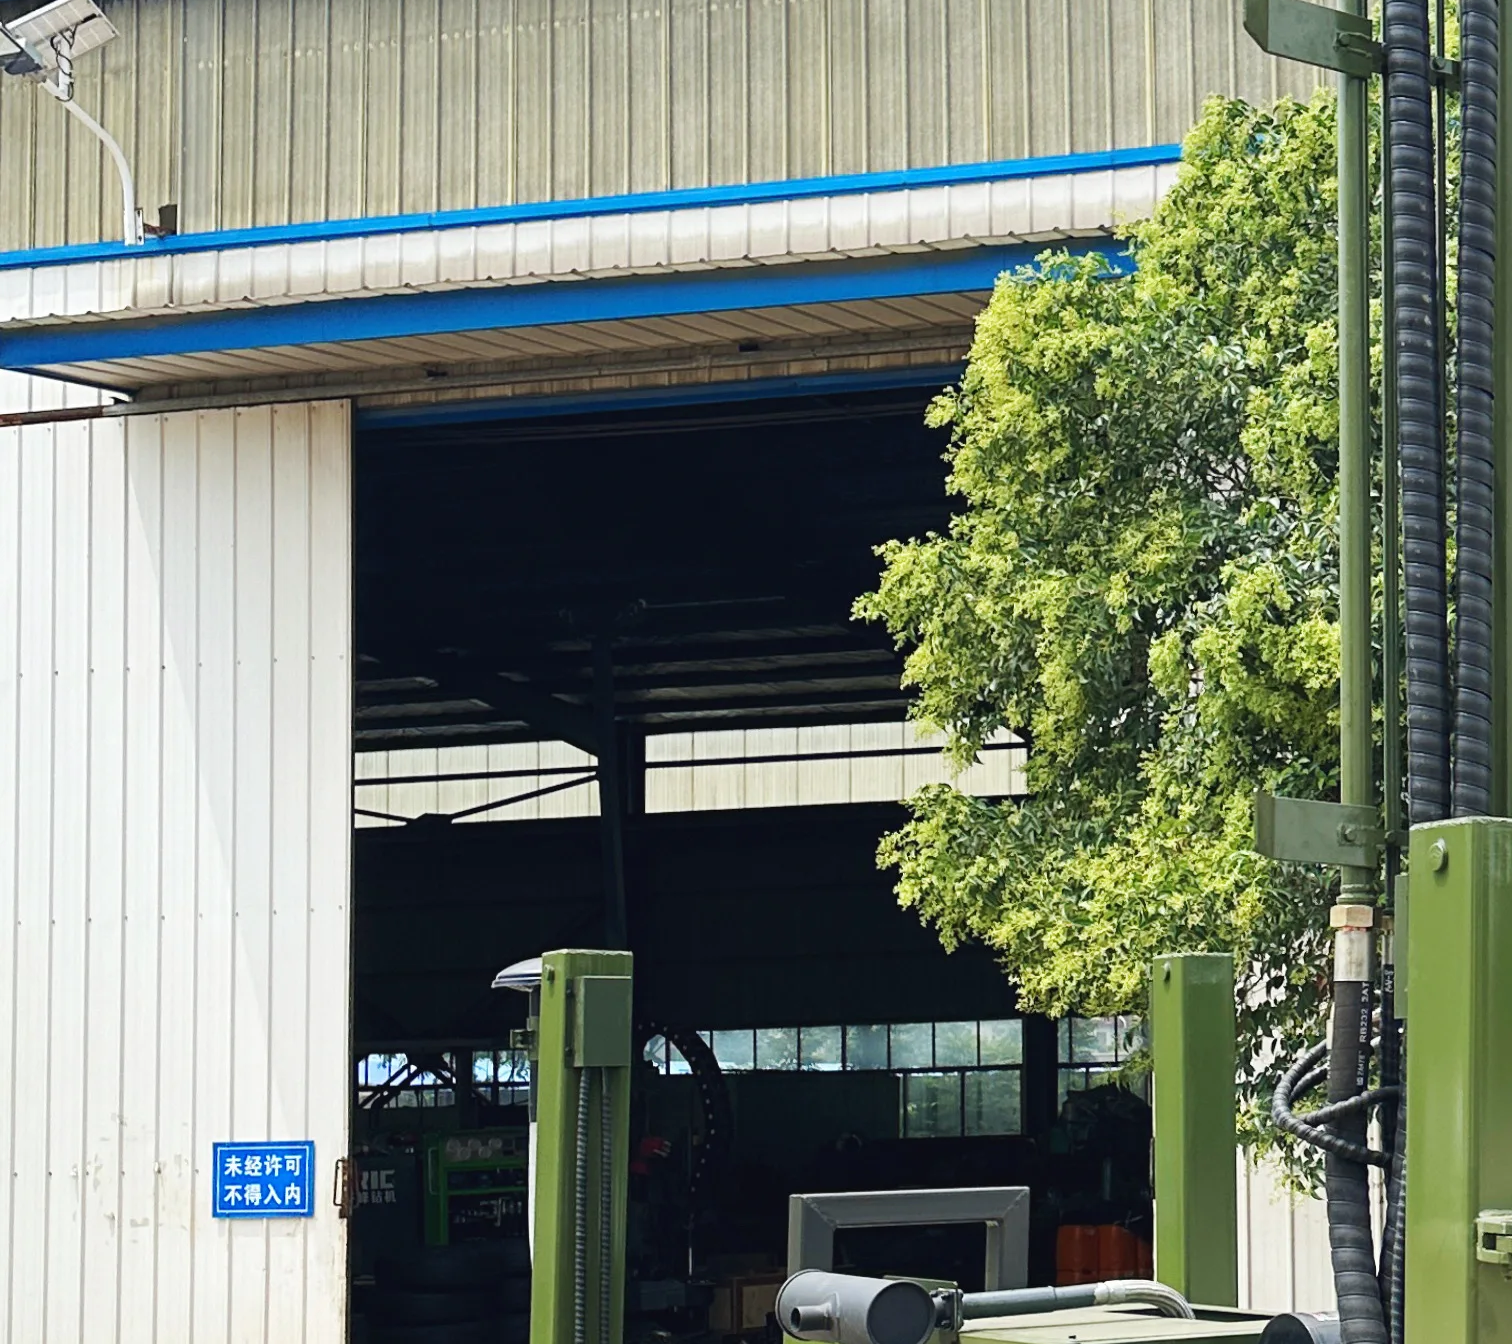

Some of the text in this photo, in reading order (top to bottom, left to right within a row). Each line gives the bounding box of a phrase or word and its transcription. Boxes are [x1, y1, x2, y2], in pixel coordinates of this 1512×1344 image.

[224, 1154, 303, 1178] 未经许可
[223, 1182, 301, 1206] 不得入内
